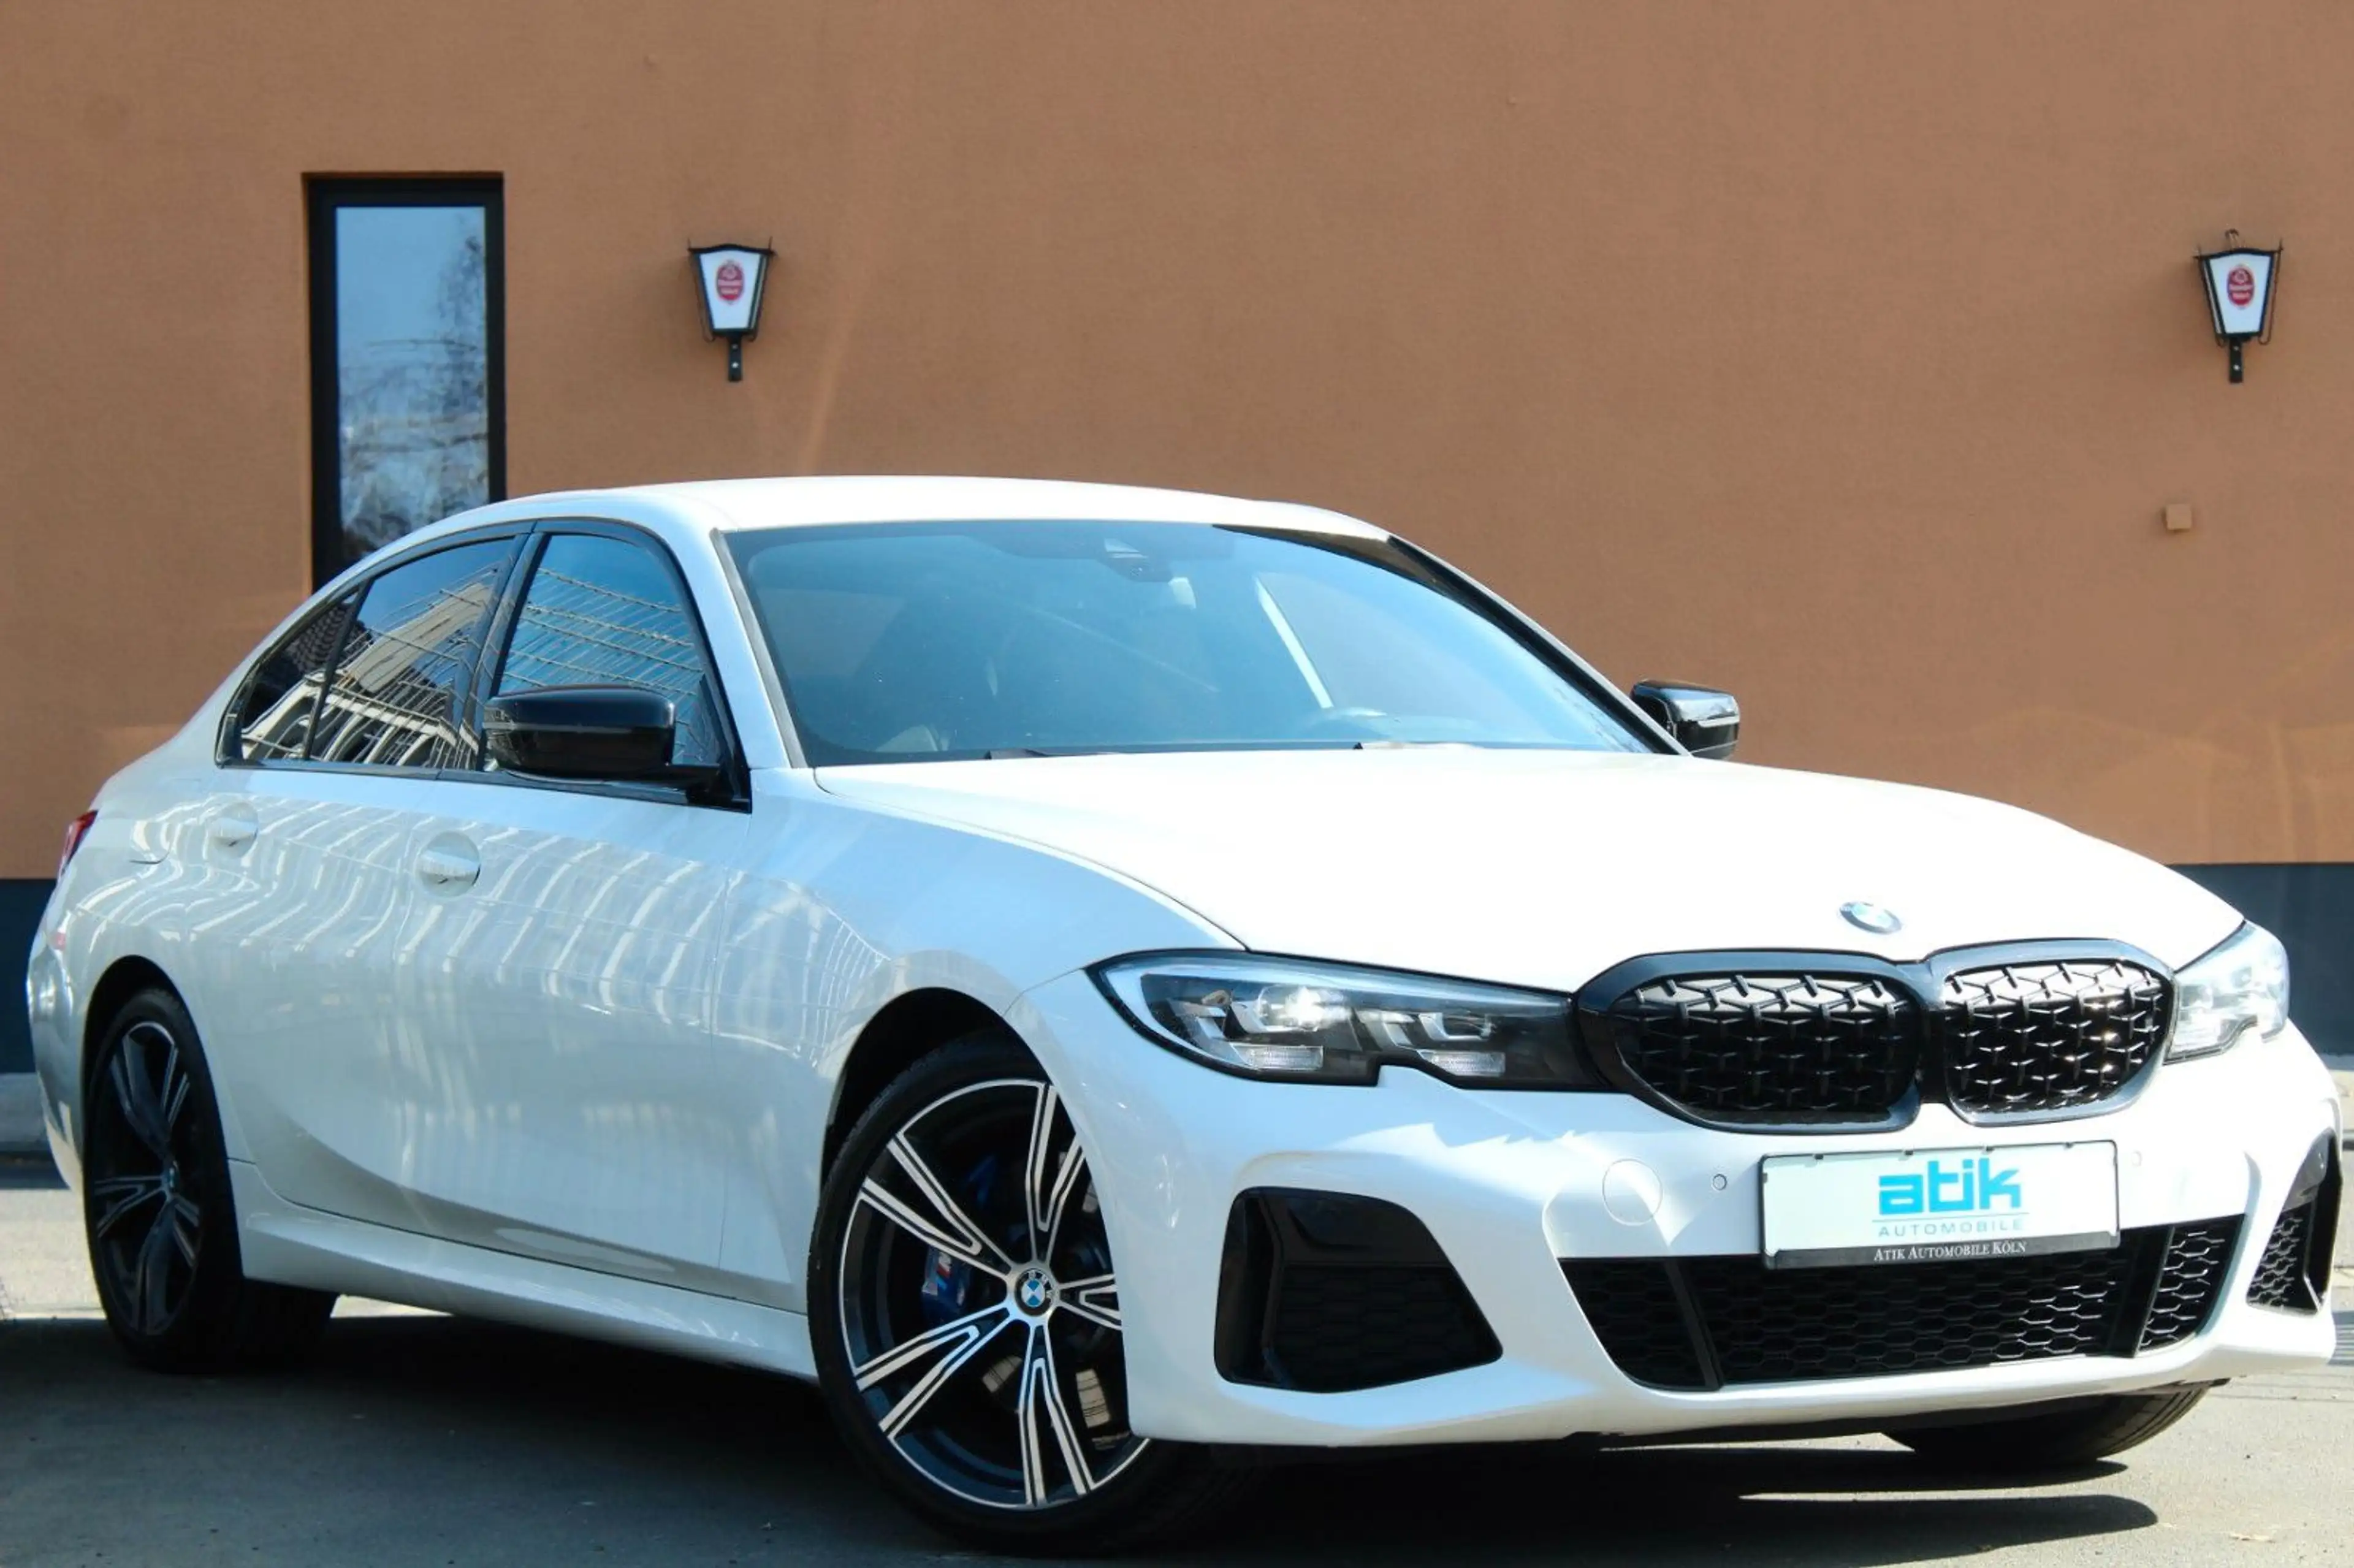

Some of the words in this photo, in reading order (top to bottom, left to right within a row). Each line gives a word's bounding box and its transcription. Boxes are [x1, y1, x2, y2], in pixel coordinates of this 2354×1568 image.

[1879, 1158, 2021, 1215] atik
[1879, 1220, 2022, 1237] AUTOMOBILE
[1874, 1249, 1905, 1261] ATIK
[1908, 1244, 1990, 1260] AUTOMOBILE
[1992, 1241, 2027, 1255] KÖLN
